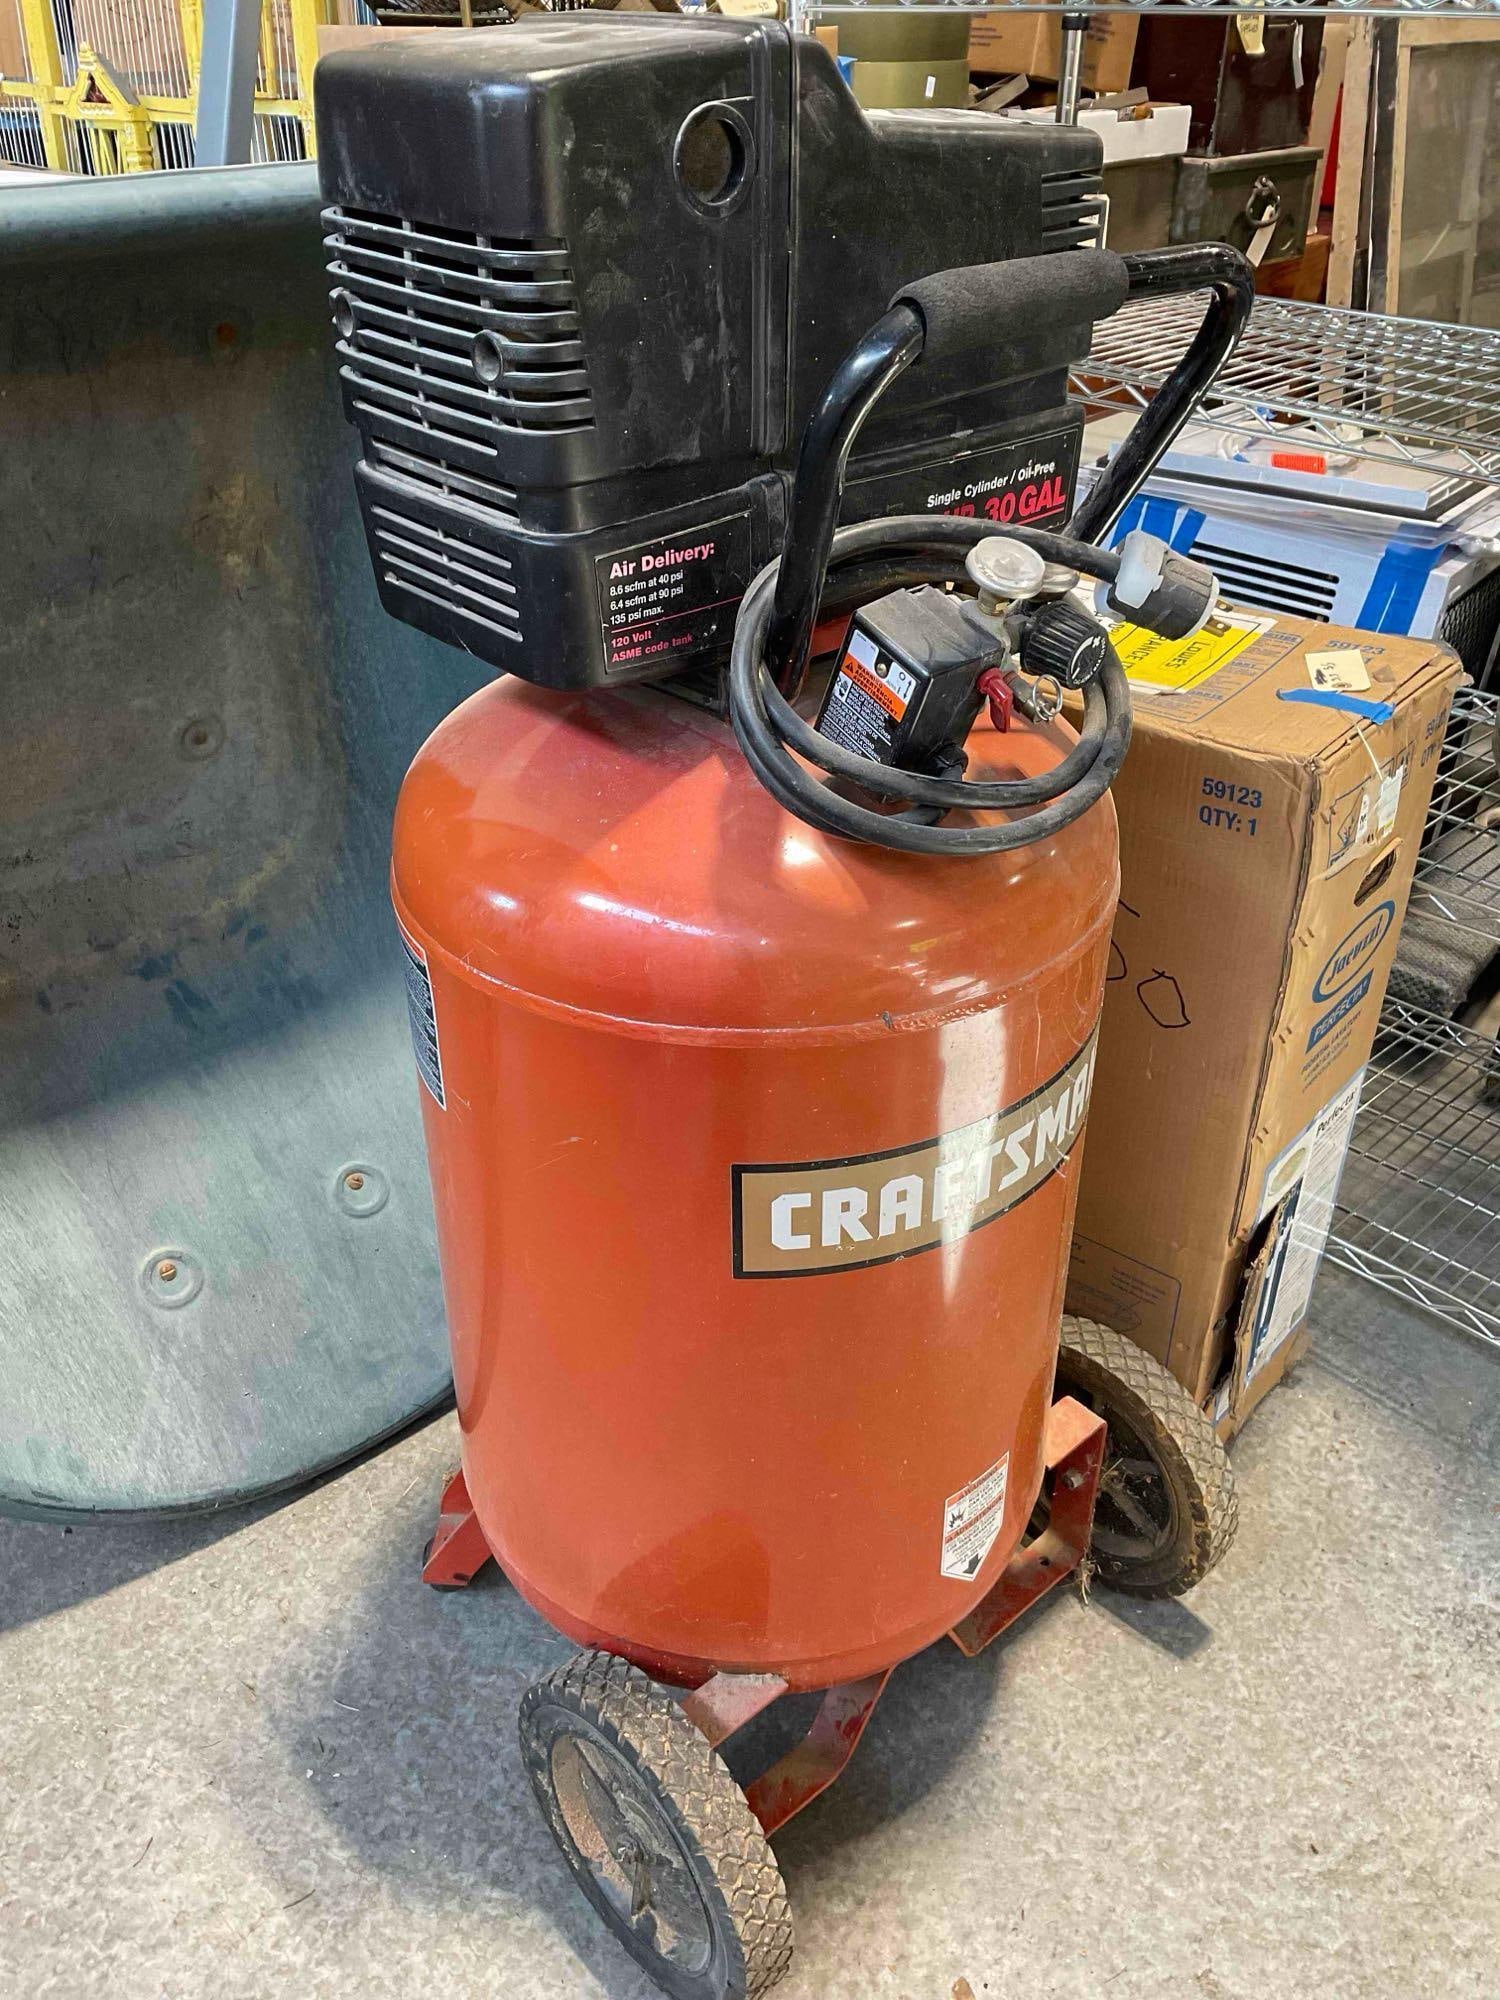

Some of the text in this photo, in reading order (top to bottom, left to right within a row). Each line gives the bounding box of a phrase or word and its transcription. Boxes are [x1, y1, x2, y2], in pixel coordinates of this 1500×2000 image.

[927, 488, 961, 508] Single
[964, 474, 1009, 498] Cylinder
[1009, 469, 1016, 484] /
[984, 492, 1016, 523] 30
[1018, 475, 1066, 517] GAL
[609, 542, 715, 579] Air Delivery:
[609, 569, 683, 597] 8.6 scfm at 40 psi
[609, 583, 683, 611] 6.4 scfm at 90 psi
[609, 605, 664, 626] 135 psi max.
[611, 630, 652, 648] 120 Volt
[611, 633, 693, 663] ASME code tank
[851, 673, 898, 717] AVERTISSEMENT
[854, 668, 893, 705] ADVERTENCIA
[1202, 777, 1262, 808] 59123
[1199, 806, 1257, 836] QTY: 1
